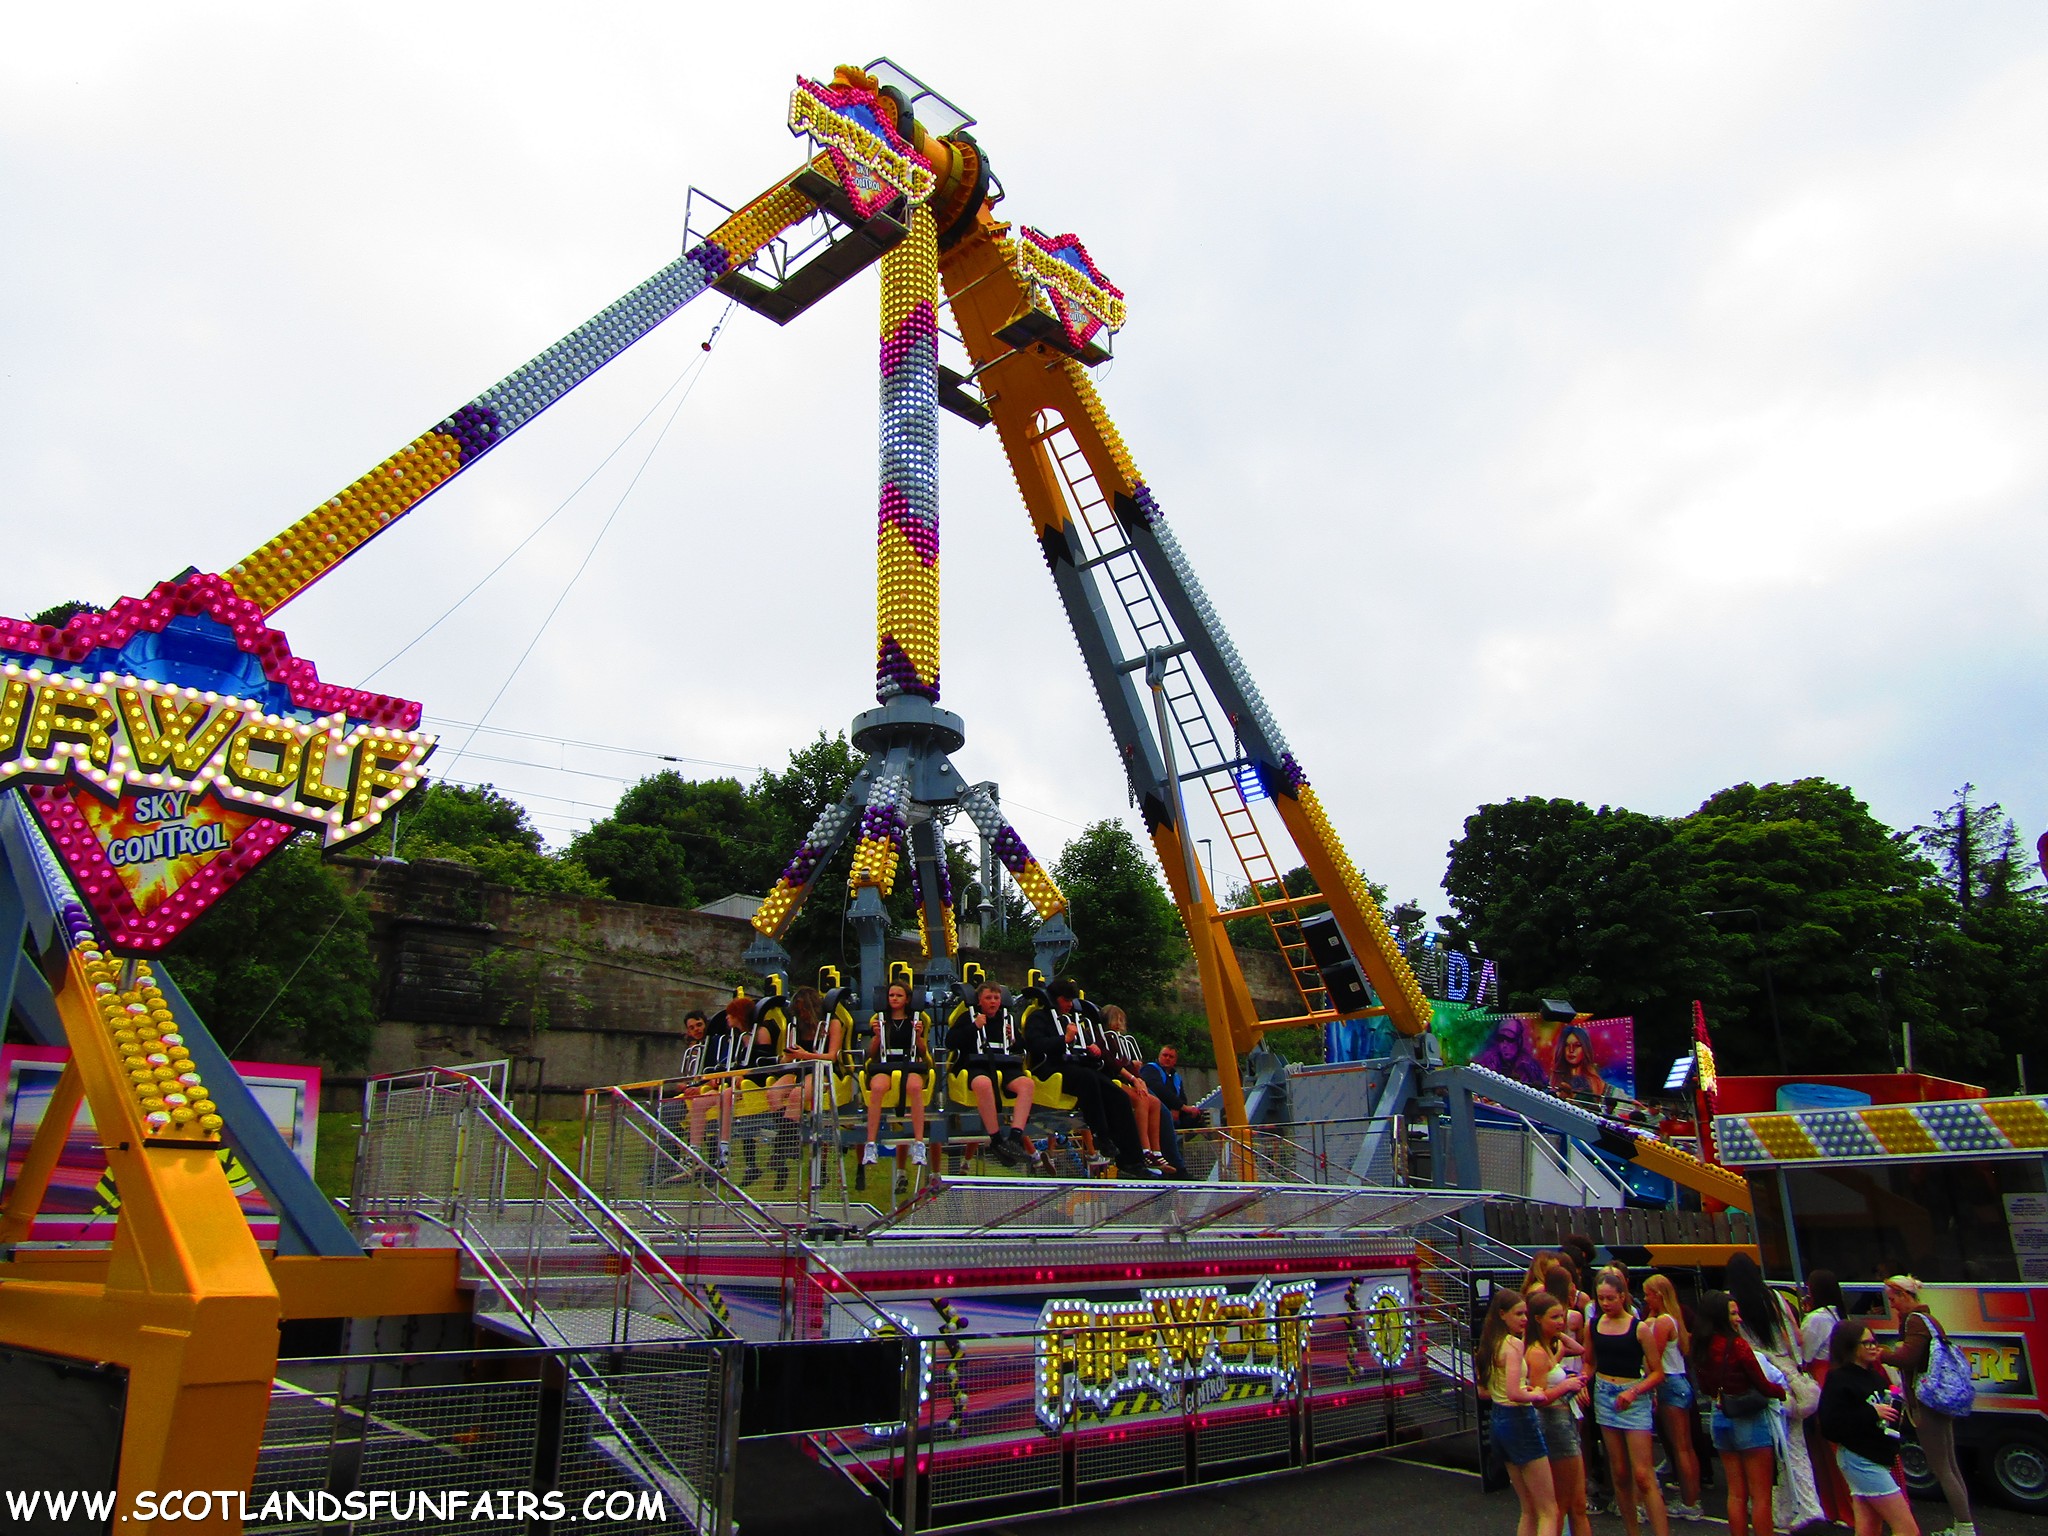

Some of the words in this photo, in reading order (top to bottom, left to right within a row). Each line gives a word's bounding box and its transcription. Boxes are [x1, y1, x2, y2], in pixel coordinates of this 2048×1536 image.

[0, 680, 417, 819] IRWOLF
[134, 791, 187, 823] SKY
[108, 822, 230, 867] CONTROL
